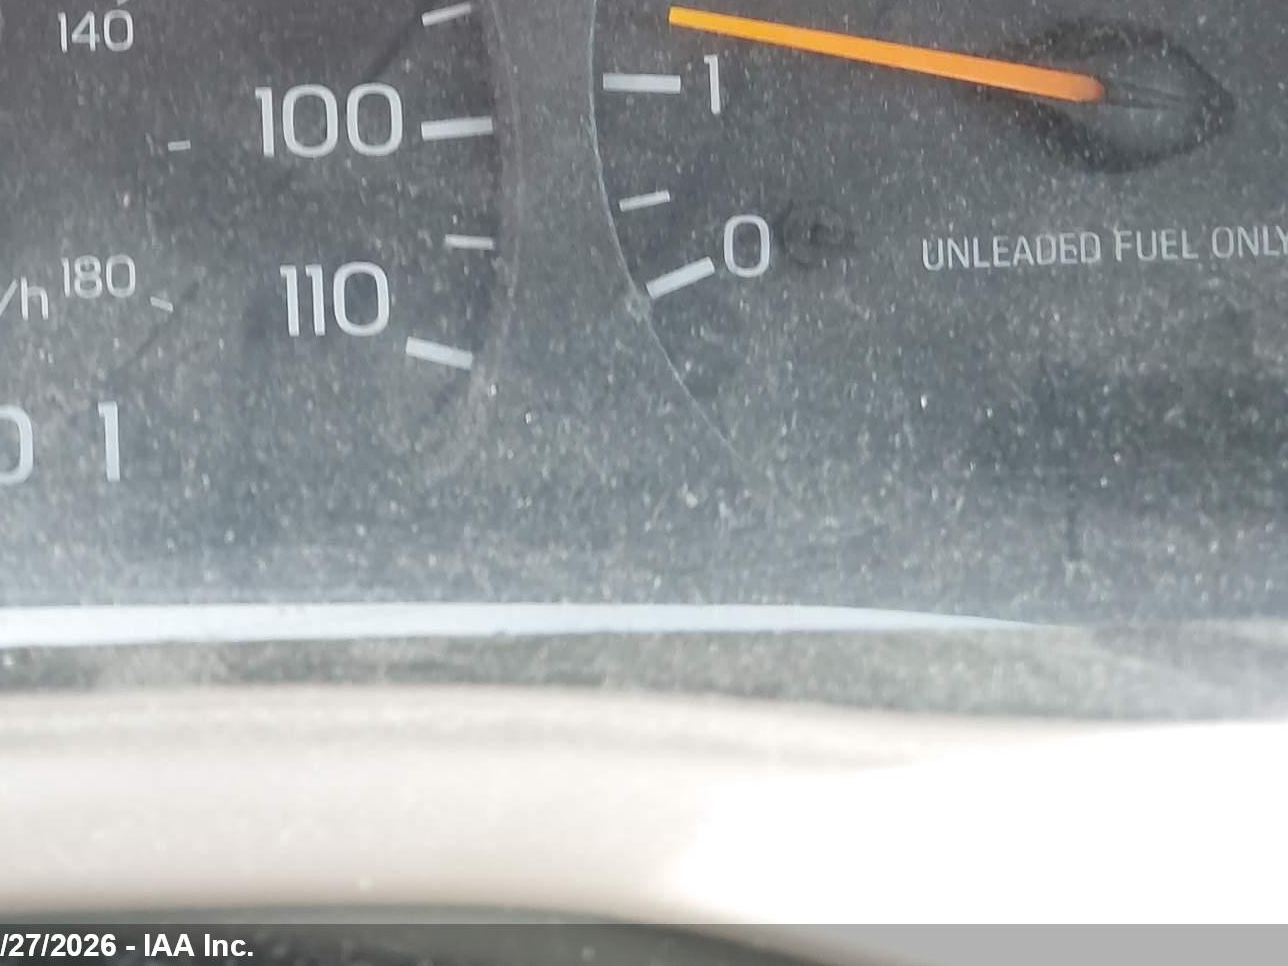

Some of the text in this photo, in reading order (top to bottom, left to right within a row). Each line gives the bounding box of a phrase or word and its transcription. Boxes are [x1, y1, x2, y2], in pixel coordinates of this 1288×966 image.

[57, 9, 134, 53] 140
[254, 83, 403, 159] 100
[723, 214, 771, 278] 0
[922, 231, 1102, 271] UNLEADED
[1111, 225, 1199, 263] FUEL
[61, 254, 137, 299] 180
[279, 262, 390, 337] 110
